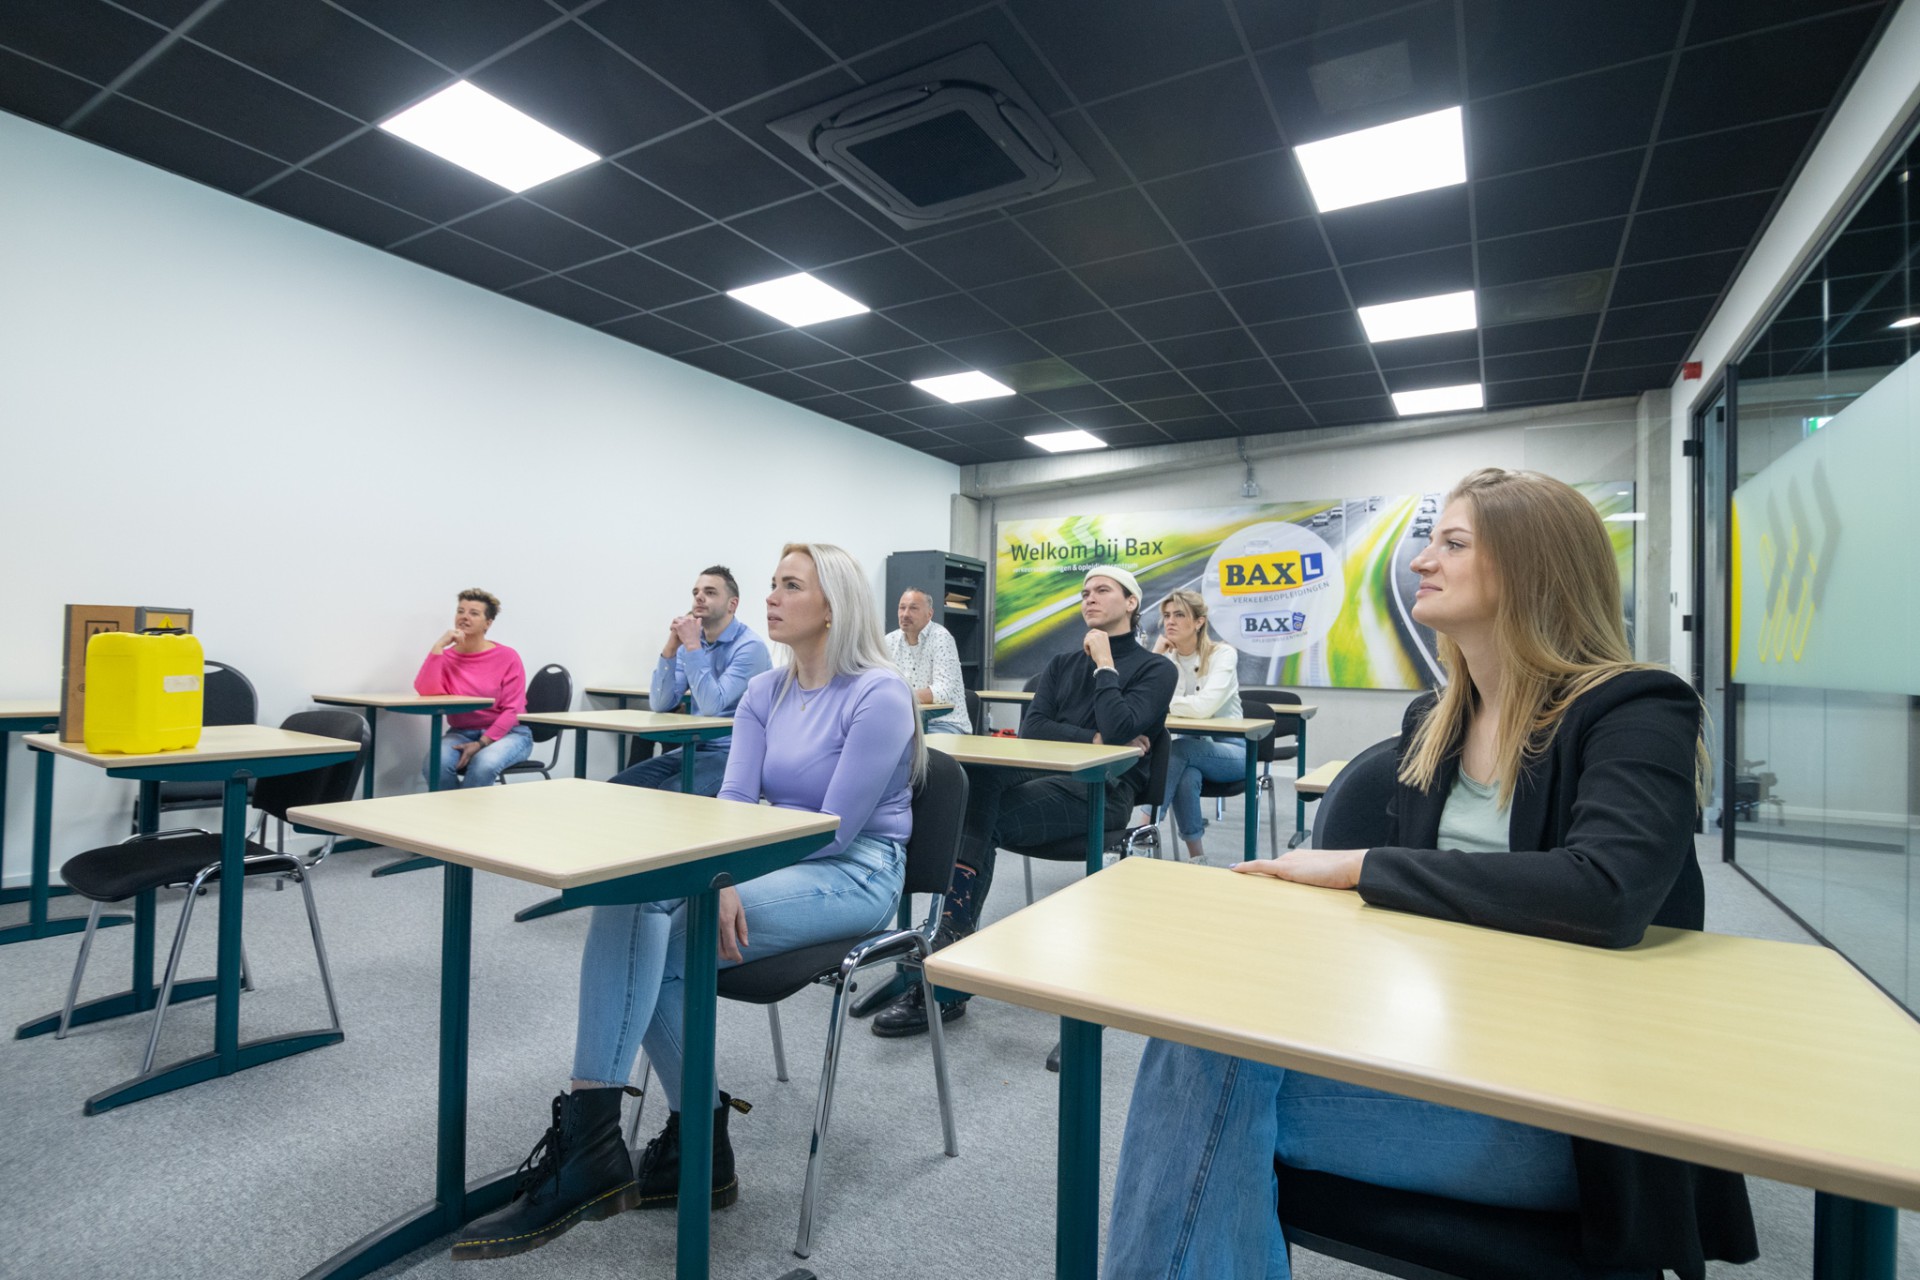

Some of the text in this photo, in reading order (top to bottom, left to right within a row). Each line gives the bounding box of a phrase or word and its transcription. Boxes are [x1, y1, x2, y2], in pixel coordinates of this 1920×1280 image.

[1011, 538, 1164, 562] Welkom bij Bax
[1225, 562, 1297, 586] BAX
[1233, 581, 1330, 604] VERKEERSOPLEIDINGEN
[1244, 617, 1290, 632] BAX
